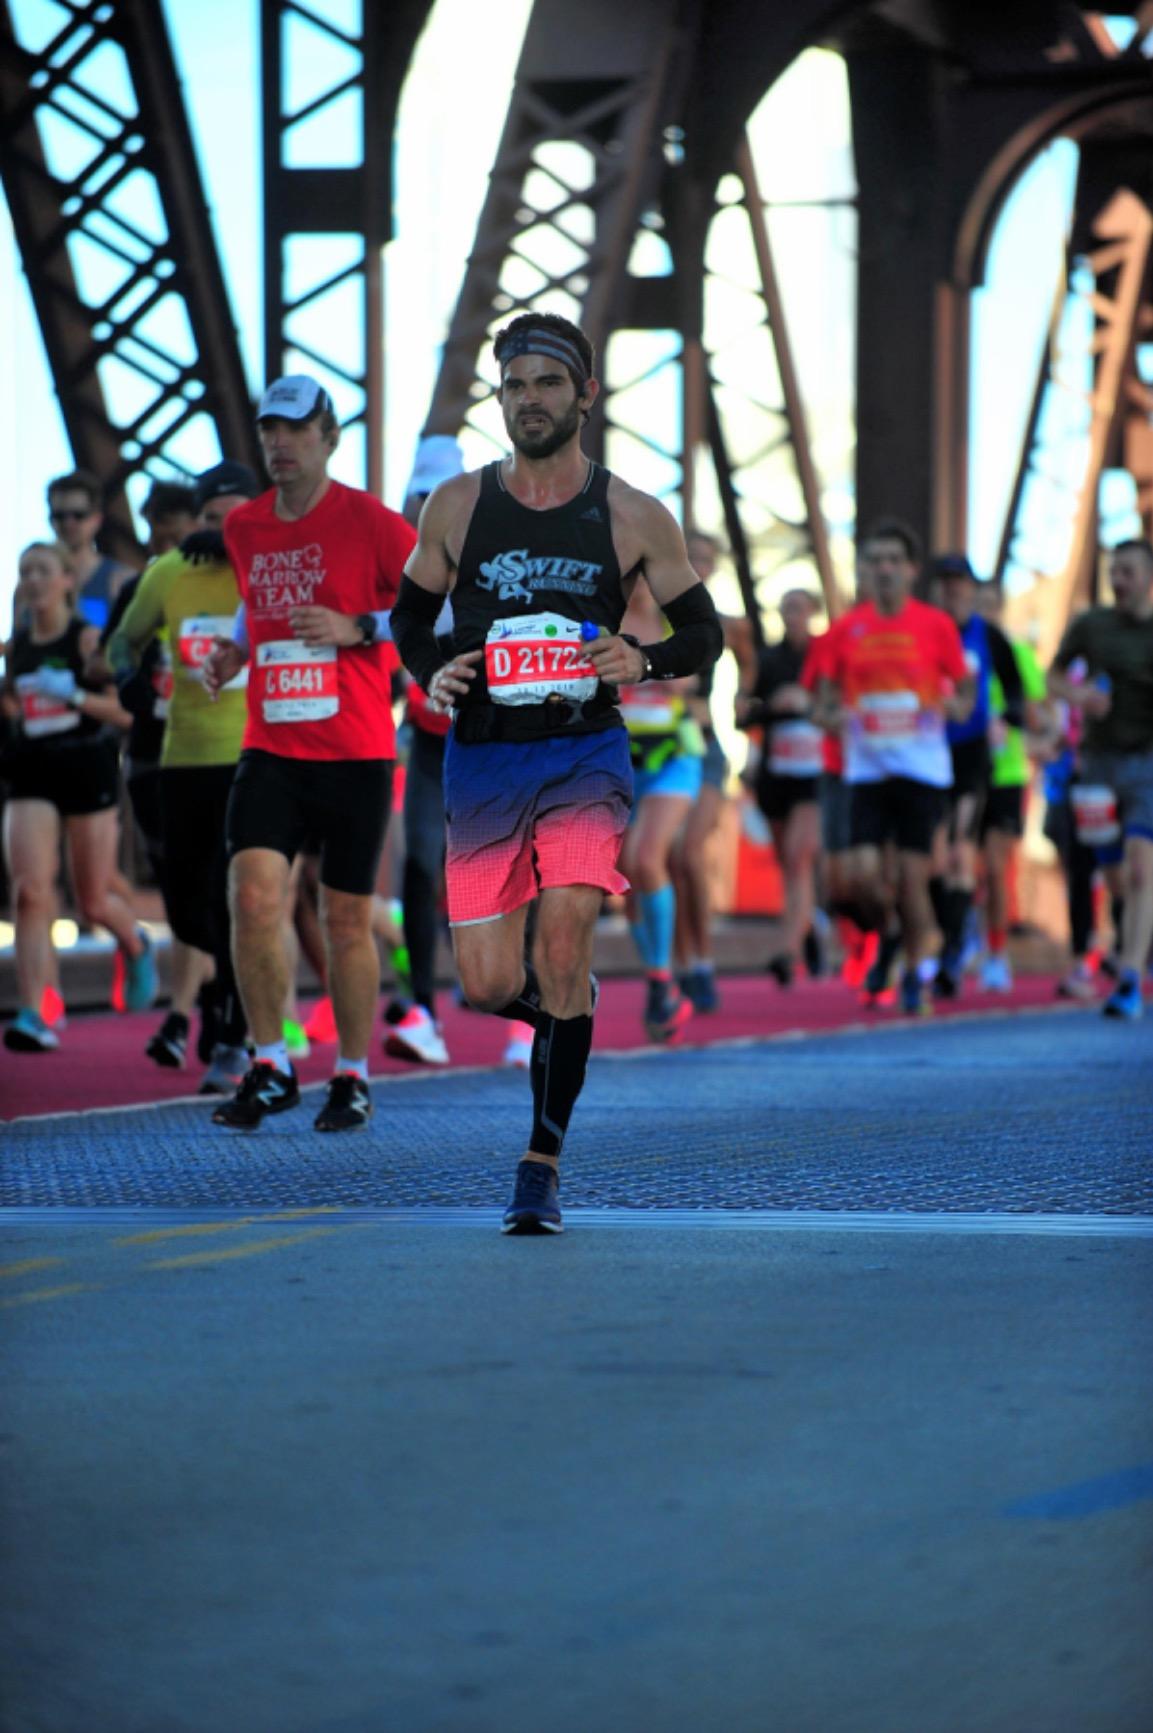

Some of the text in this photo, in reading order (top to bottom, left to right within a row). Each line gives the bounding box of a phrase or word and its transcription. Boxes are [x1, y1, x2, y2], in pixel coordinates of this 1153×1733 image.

[252, 551, 303, 571] BONE
[498, 549, 603, 582] SWIFT
[249, 568, 327, 586] MARROW
[256, 586, 314, 608] TEAM
[493, 648, 511, 678] D
[279, 667, 324, 693] 6441
